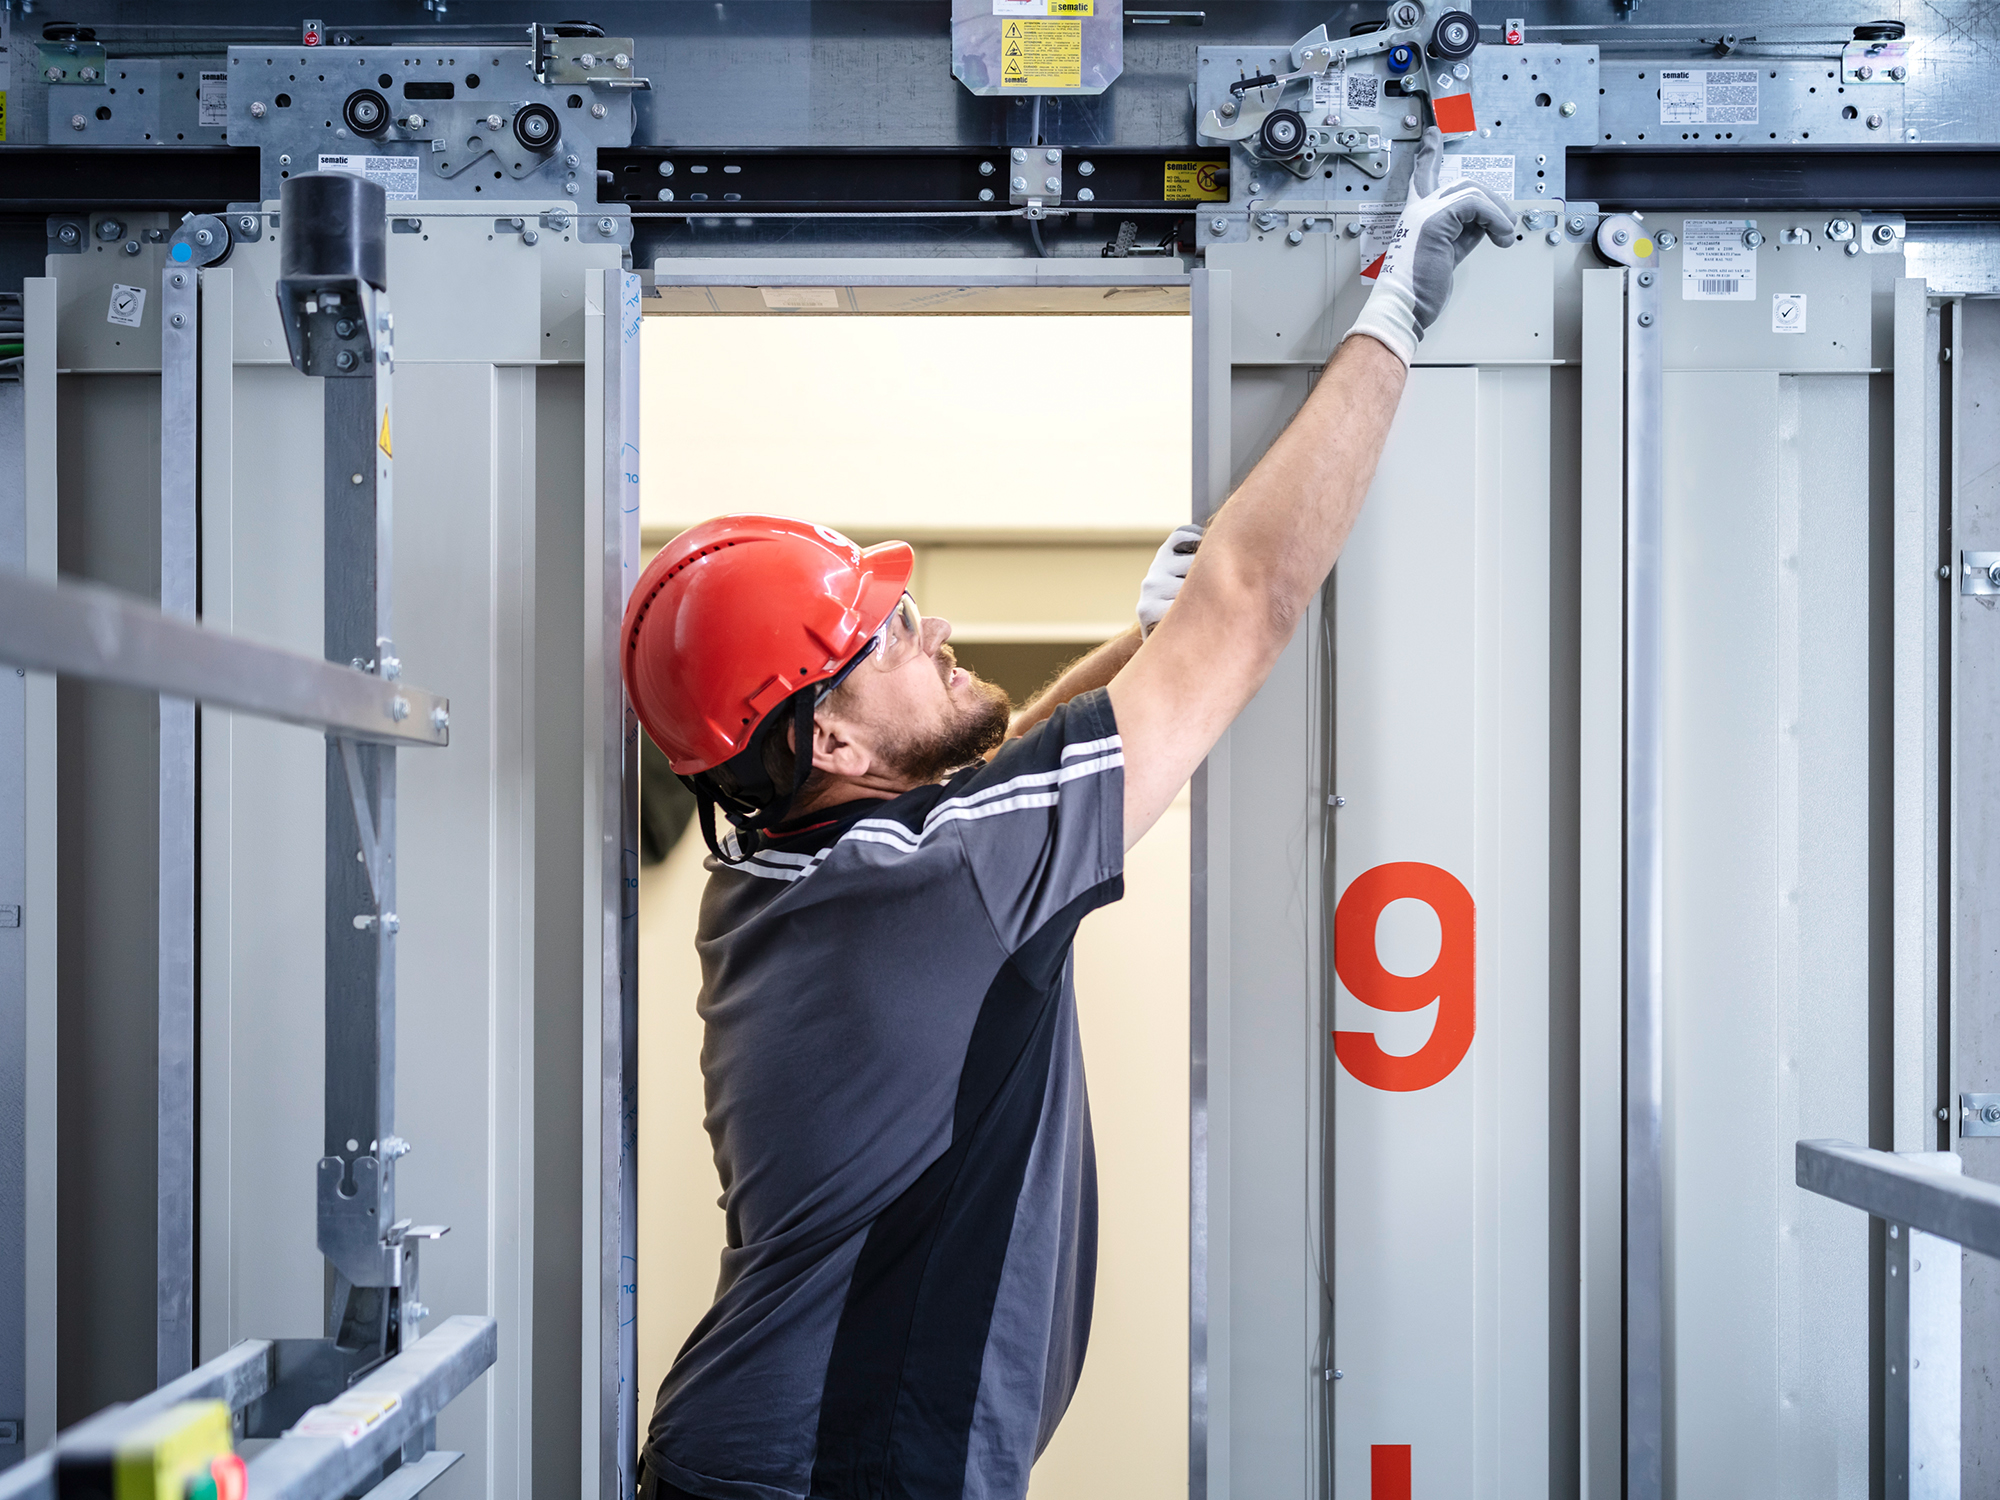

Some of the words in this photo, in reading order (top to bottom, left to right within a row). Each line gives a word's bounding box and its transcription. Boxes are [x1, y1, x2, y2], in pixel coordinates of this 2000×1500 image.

[1058, 2, 1088, 12] sematic
[321, 156, 348, 164] sematic
[1332, 861, 1476, 1092] 9
